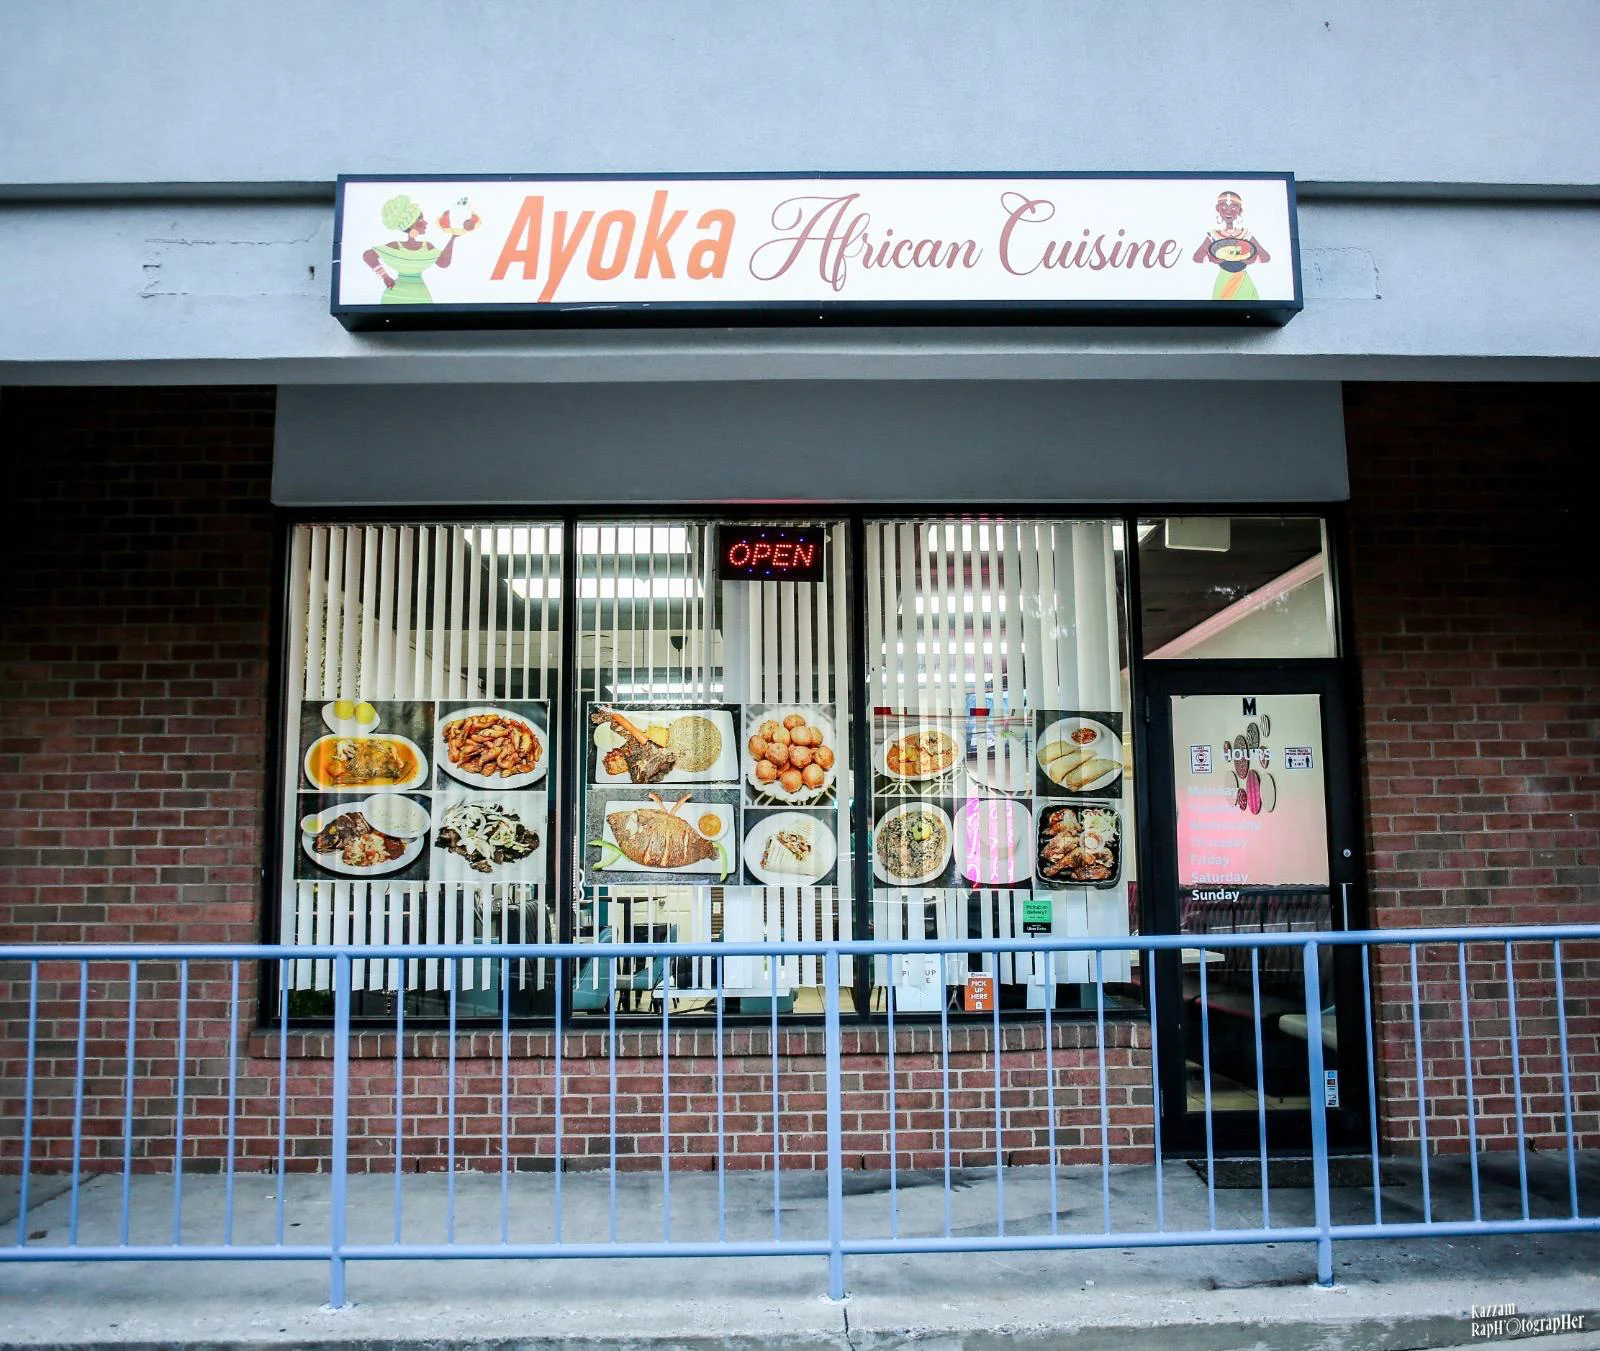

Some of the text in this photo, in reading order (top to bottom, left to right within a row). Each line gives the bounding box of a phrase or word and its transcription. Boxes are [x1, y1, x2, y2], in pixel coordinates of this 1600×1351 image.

[490, 190, 1182, 303] Ayoka African Cuisine
[729, 543, 814, 566] OPEN
[1191, 854, 1230, 867] Friday
[1192, 872, 1248, 884] Saturday
[1192, 889, 1240, 903] Sunday
